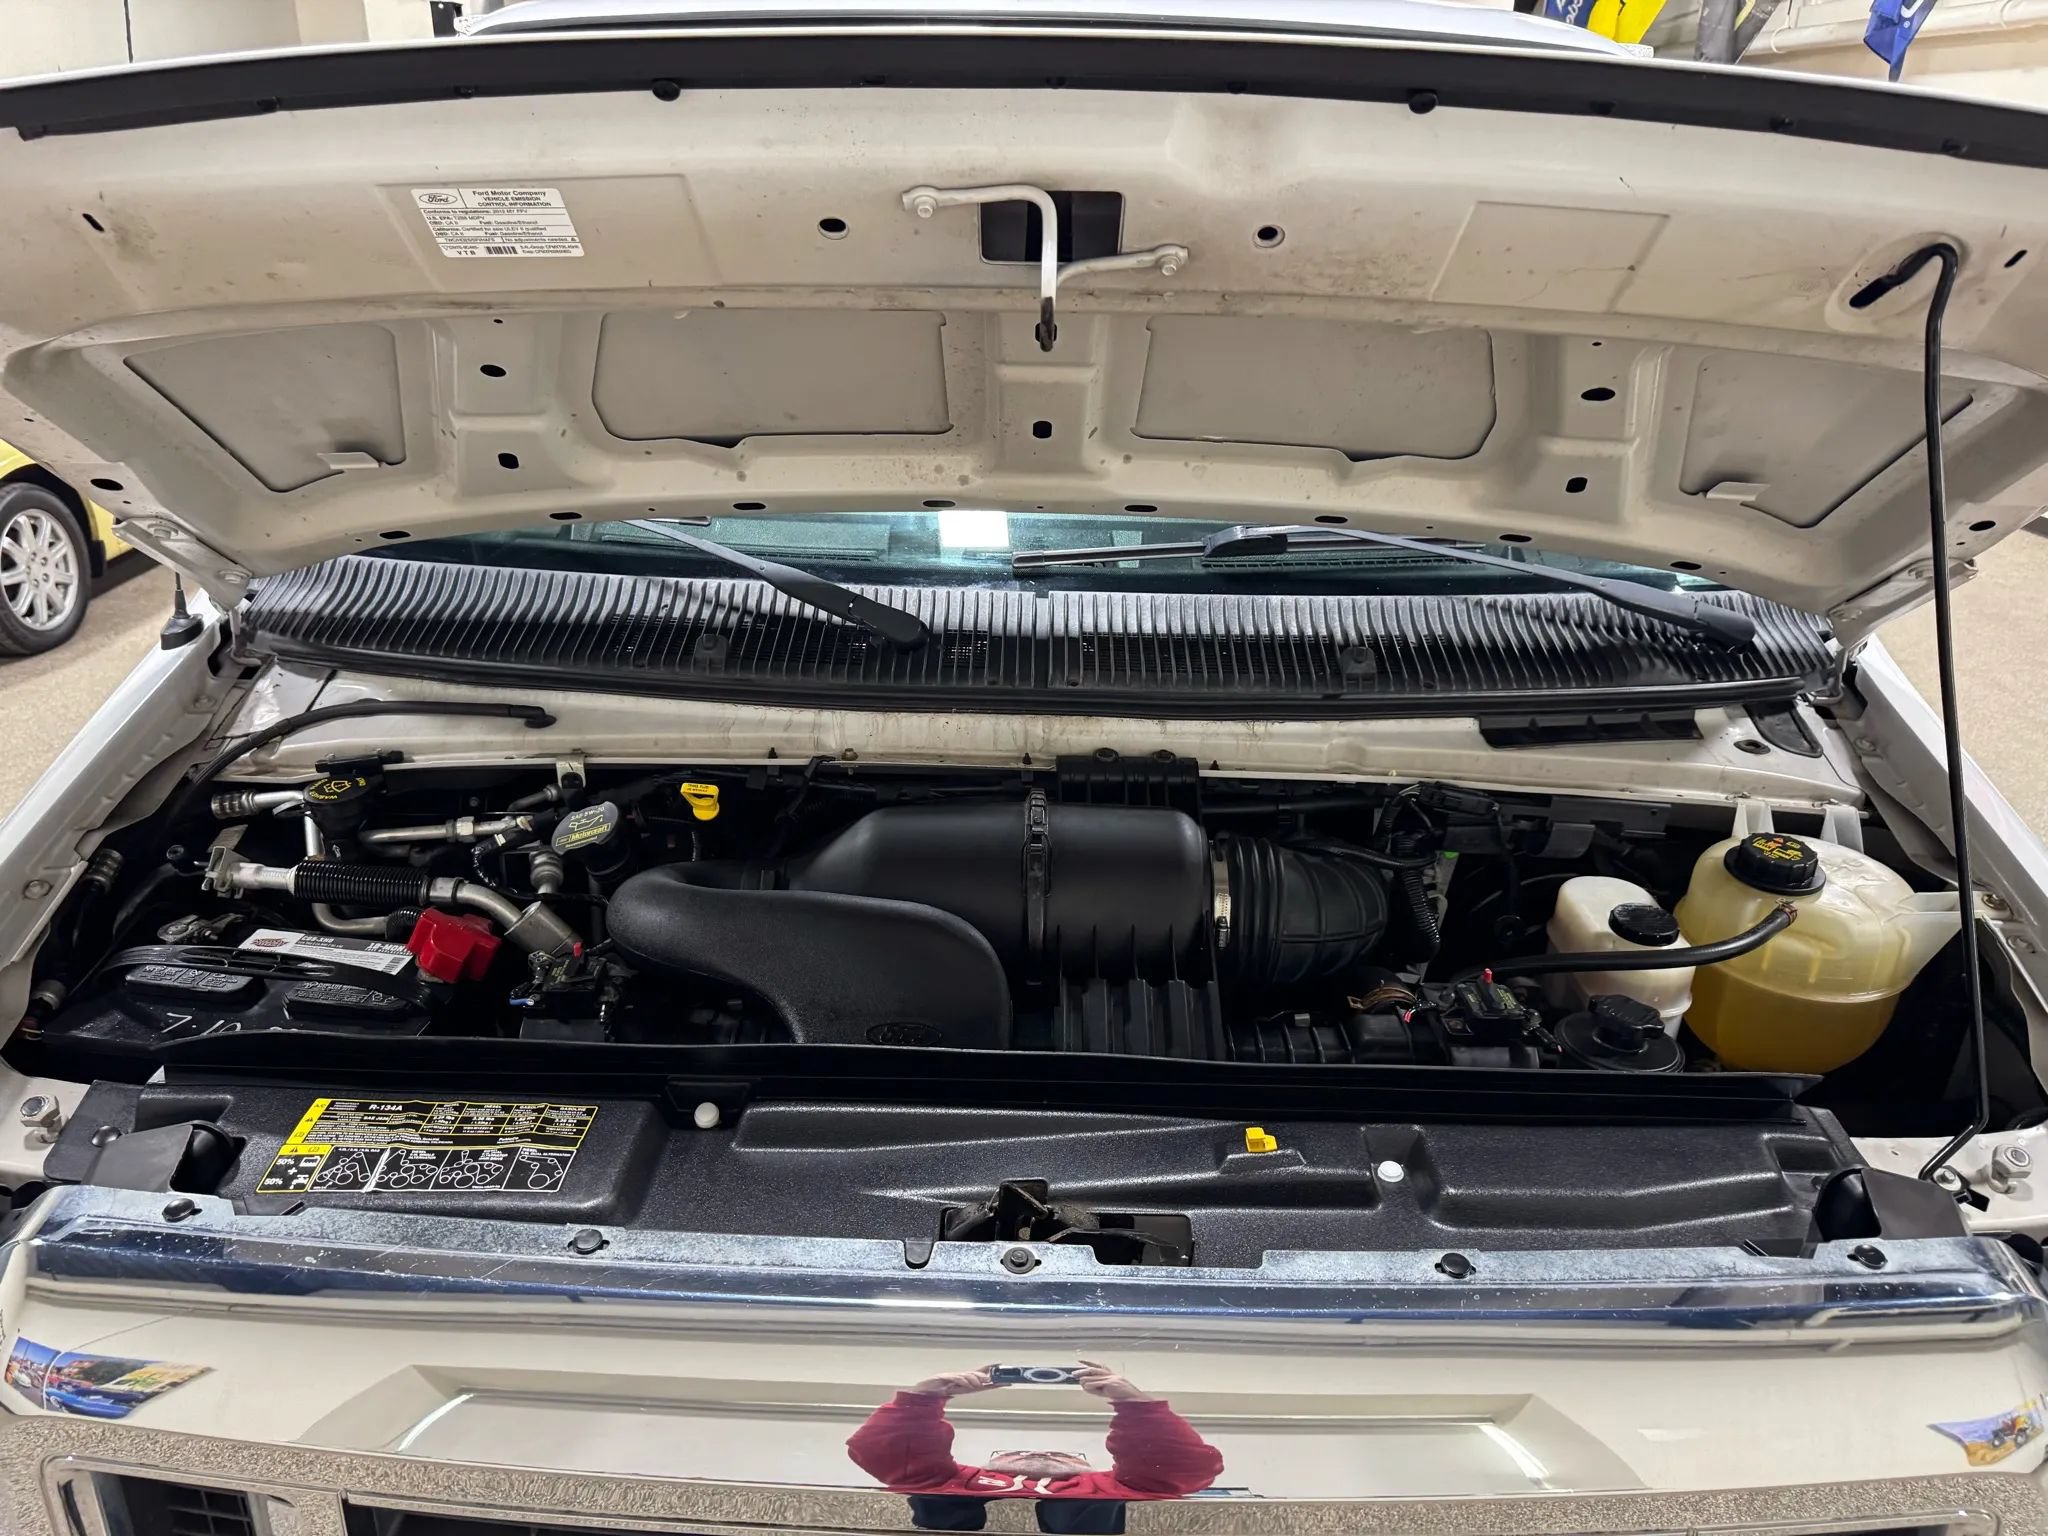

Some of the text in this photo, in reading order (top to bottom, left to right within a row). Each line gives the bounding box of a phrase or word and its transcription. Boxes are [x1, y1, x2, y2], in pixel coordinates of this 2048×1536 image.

[427, 194, 450, 203] Ford
[570, 824, 609, 840] Motorcraft
[276, 1158, 296, 1166] 50%
[263, 1178, 284, 1186] 50%
